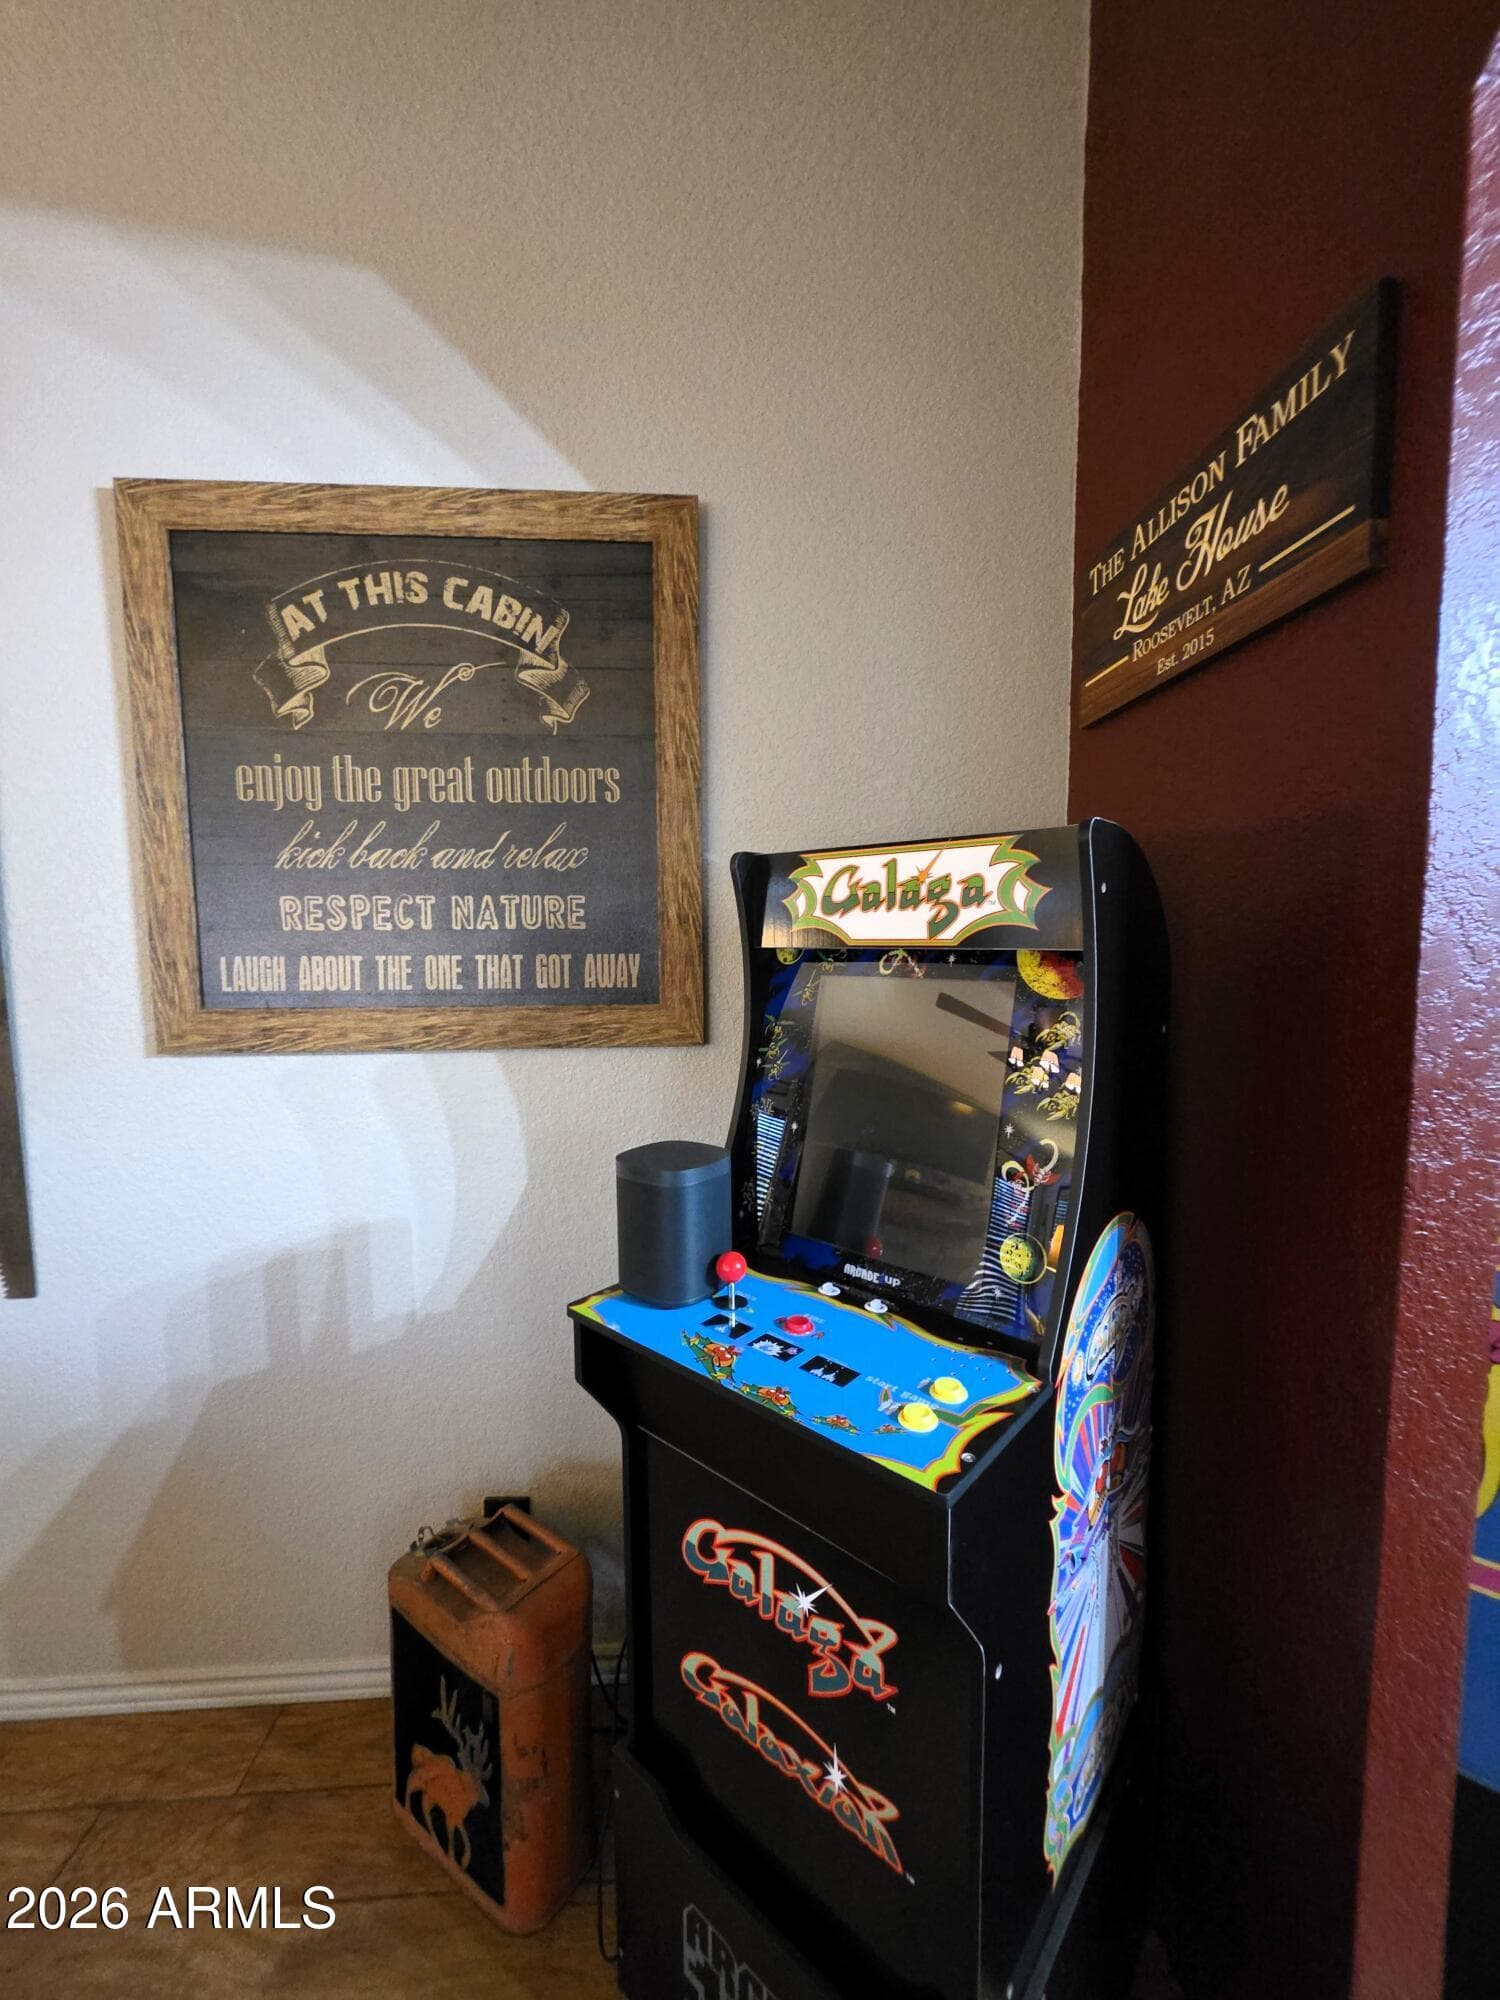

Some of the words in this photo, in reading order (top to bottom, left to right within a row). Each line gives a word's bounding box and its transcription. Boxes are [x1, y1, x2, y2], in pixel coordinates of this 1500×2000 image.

[1089, 547, 1126, 596] THE
[1130, 450, 1227, 562] ALLISON
[1235, 330, 1356, 469] FAMILY
[1113, 562, 1169, 641] Lake
[1177, 484, 1290, 592] House
[281, 590, 327, 642] AT
[338, 570, 428, 611] THIS
[442, 577, 558, 654] CABIN
[1132, 596, 1217, 662] ROOSEVELT,
[1220, 569, 1252, 607] AZ
[1156, 654, 1179, 676] Est.
[1182, 628, 1215, 661] 2015
[345, 662, 506, 731] We
[235, 753, 323, 812] enjoy
[332, 754, 382, 803] the
[393, 755, 476, 812] great
[485, 756, 621, 804] outdoors
[274, 819, 358, 870] kick
[348, 820, 440, 870] back
[430, 830, 512, 871] and
[503, 822, 588, 872] relax
[279, 895, 435, 931] RESPECT
[451, 895, 586, 930] NATURE
[821, 858, 991, 942] Galaga
[219, 956, 287, 993] LAUGH
[299, 956, 362, 992] ABOUT
[375, 955, 413, 991] THE
[424, 955, 463, 990] ONE
[475, 954, 523, 990] THAT
[536, 954, 576, 990] GOT
[584, 954, 640, 989] AWAY
[682, 1519, 899, 1699] Galaga
